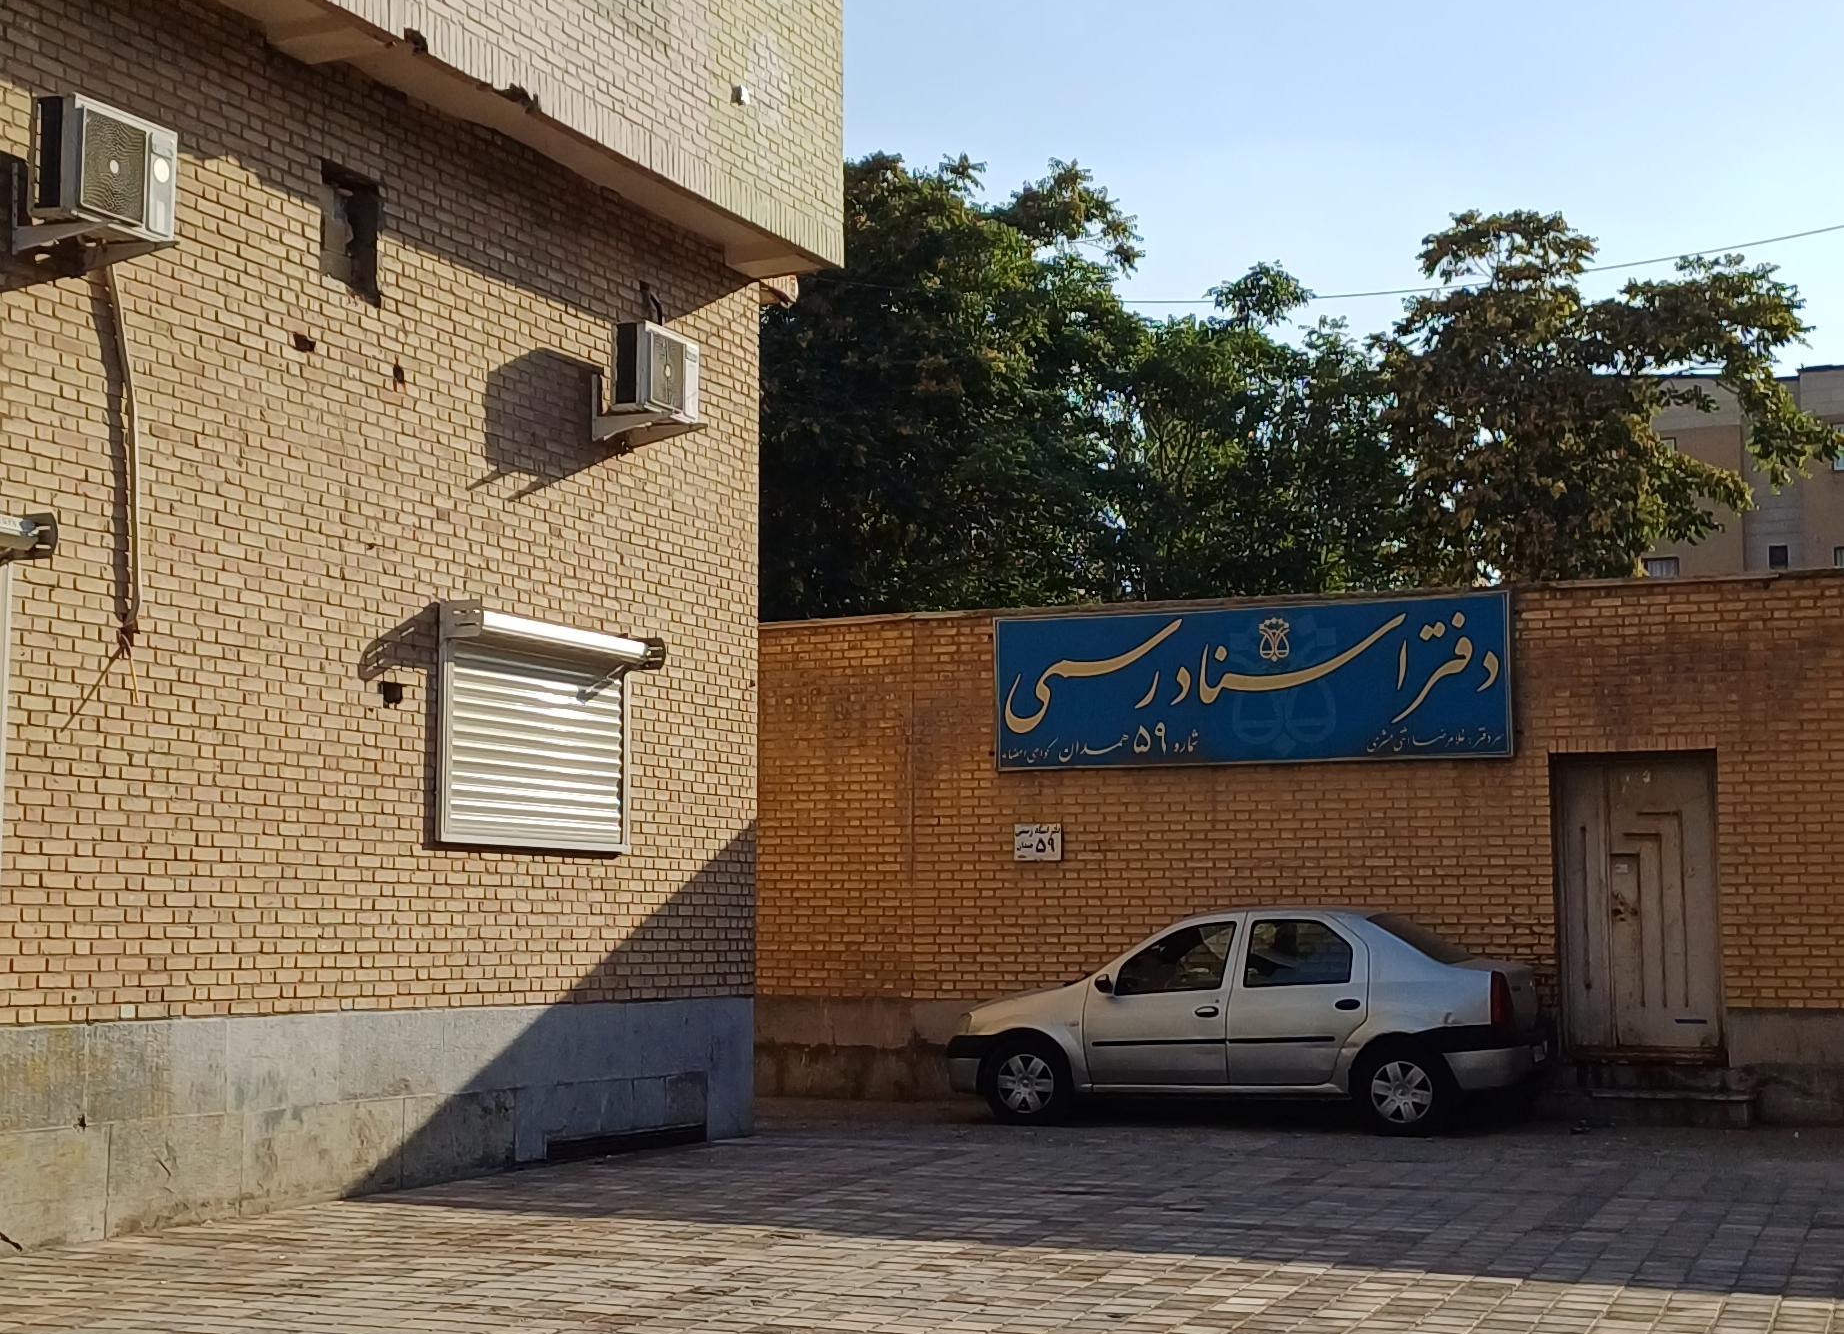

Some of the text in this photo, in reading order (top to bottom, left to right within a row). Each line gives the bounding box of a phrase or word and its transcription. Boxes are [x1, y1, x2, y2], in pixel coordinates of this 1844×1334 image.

[1004, 610, 1500, 734] دفتر اسناد رسمی
[1058, 733, 1130, 763] همدان
[1133, 721, 1168, 756] ۵۹
[1035, 837, 1055, 853] ۵۹
